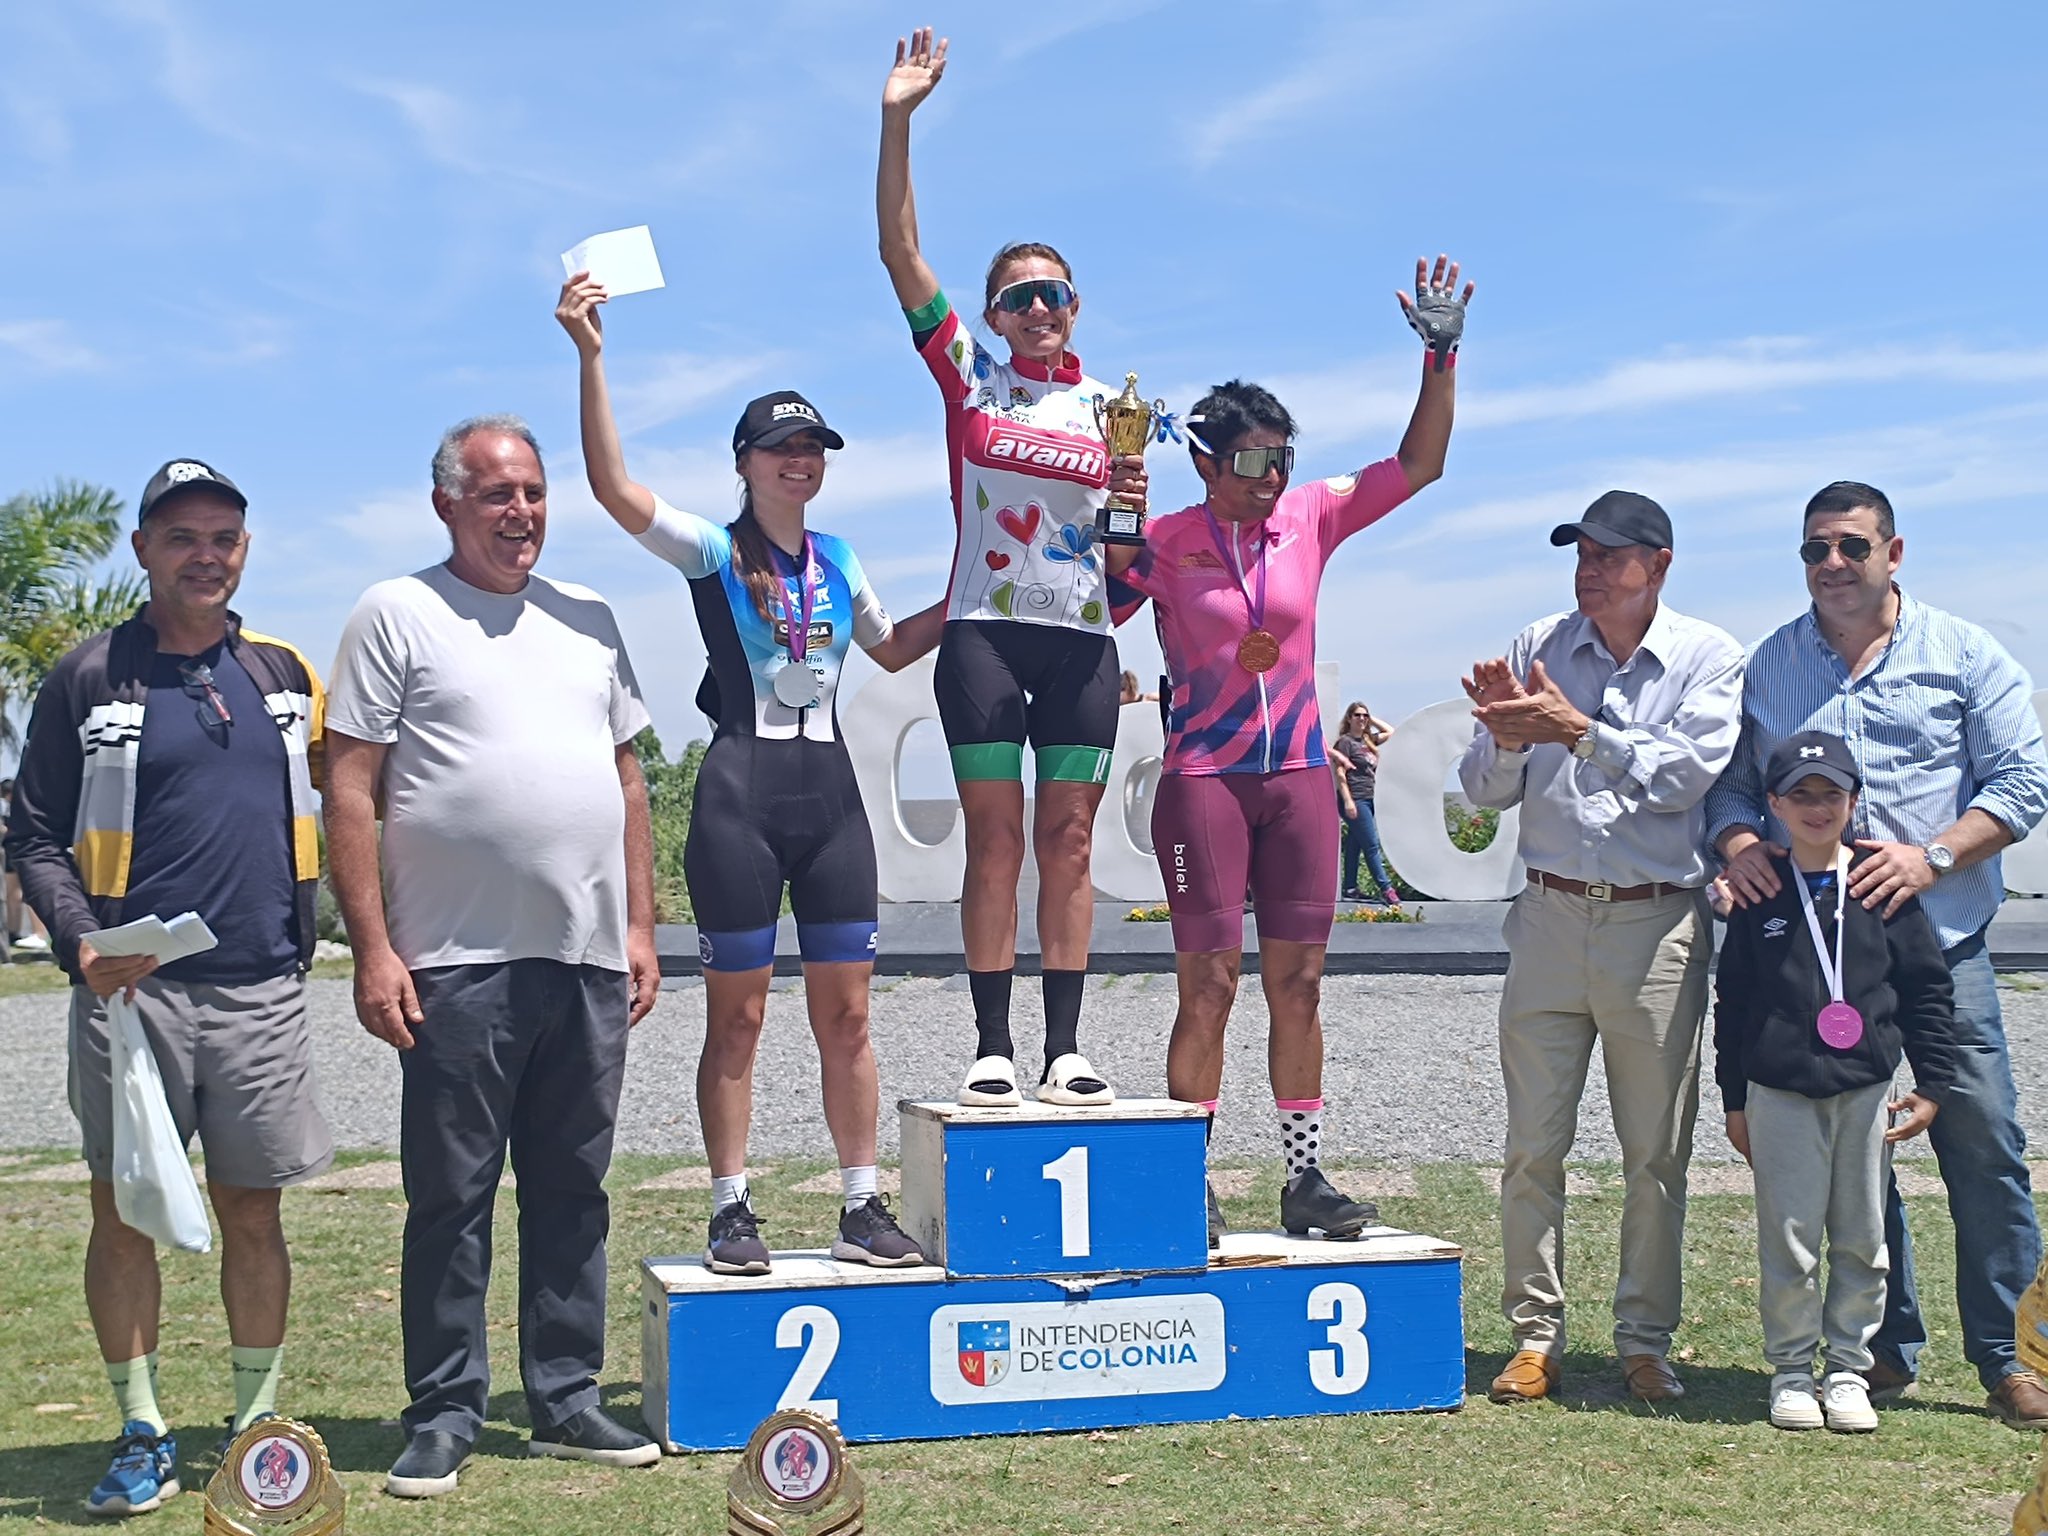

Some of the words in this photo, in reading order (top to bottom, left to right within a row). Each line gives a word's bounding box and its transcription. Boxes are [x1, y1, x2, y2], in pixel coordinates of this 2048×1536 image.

[990, 438, 1103, 475] avanti
[1174, 844, 1189, 893] balek
[1042, 1146, 1090, 1257] 1
[1019, 1318, 1196, 1347] INTENDENCIA
[1307, 1282, 1370, 1396] 3
[775, 1304, 840, 1421] 2
[1020, 1350, 1054, 1373] DE
[1058, 1342, 1198, 1371] COLONIA
